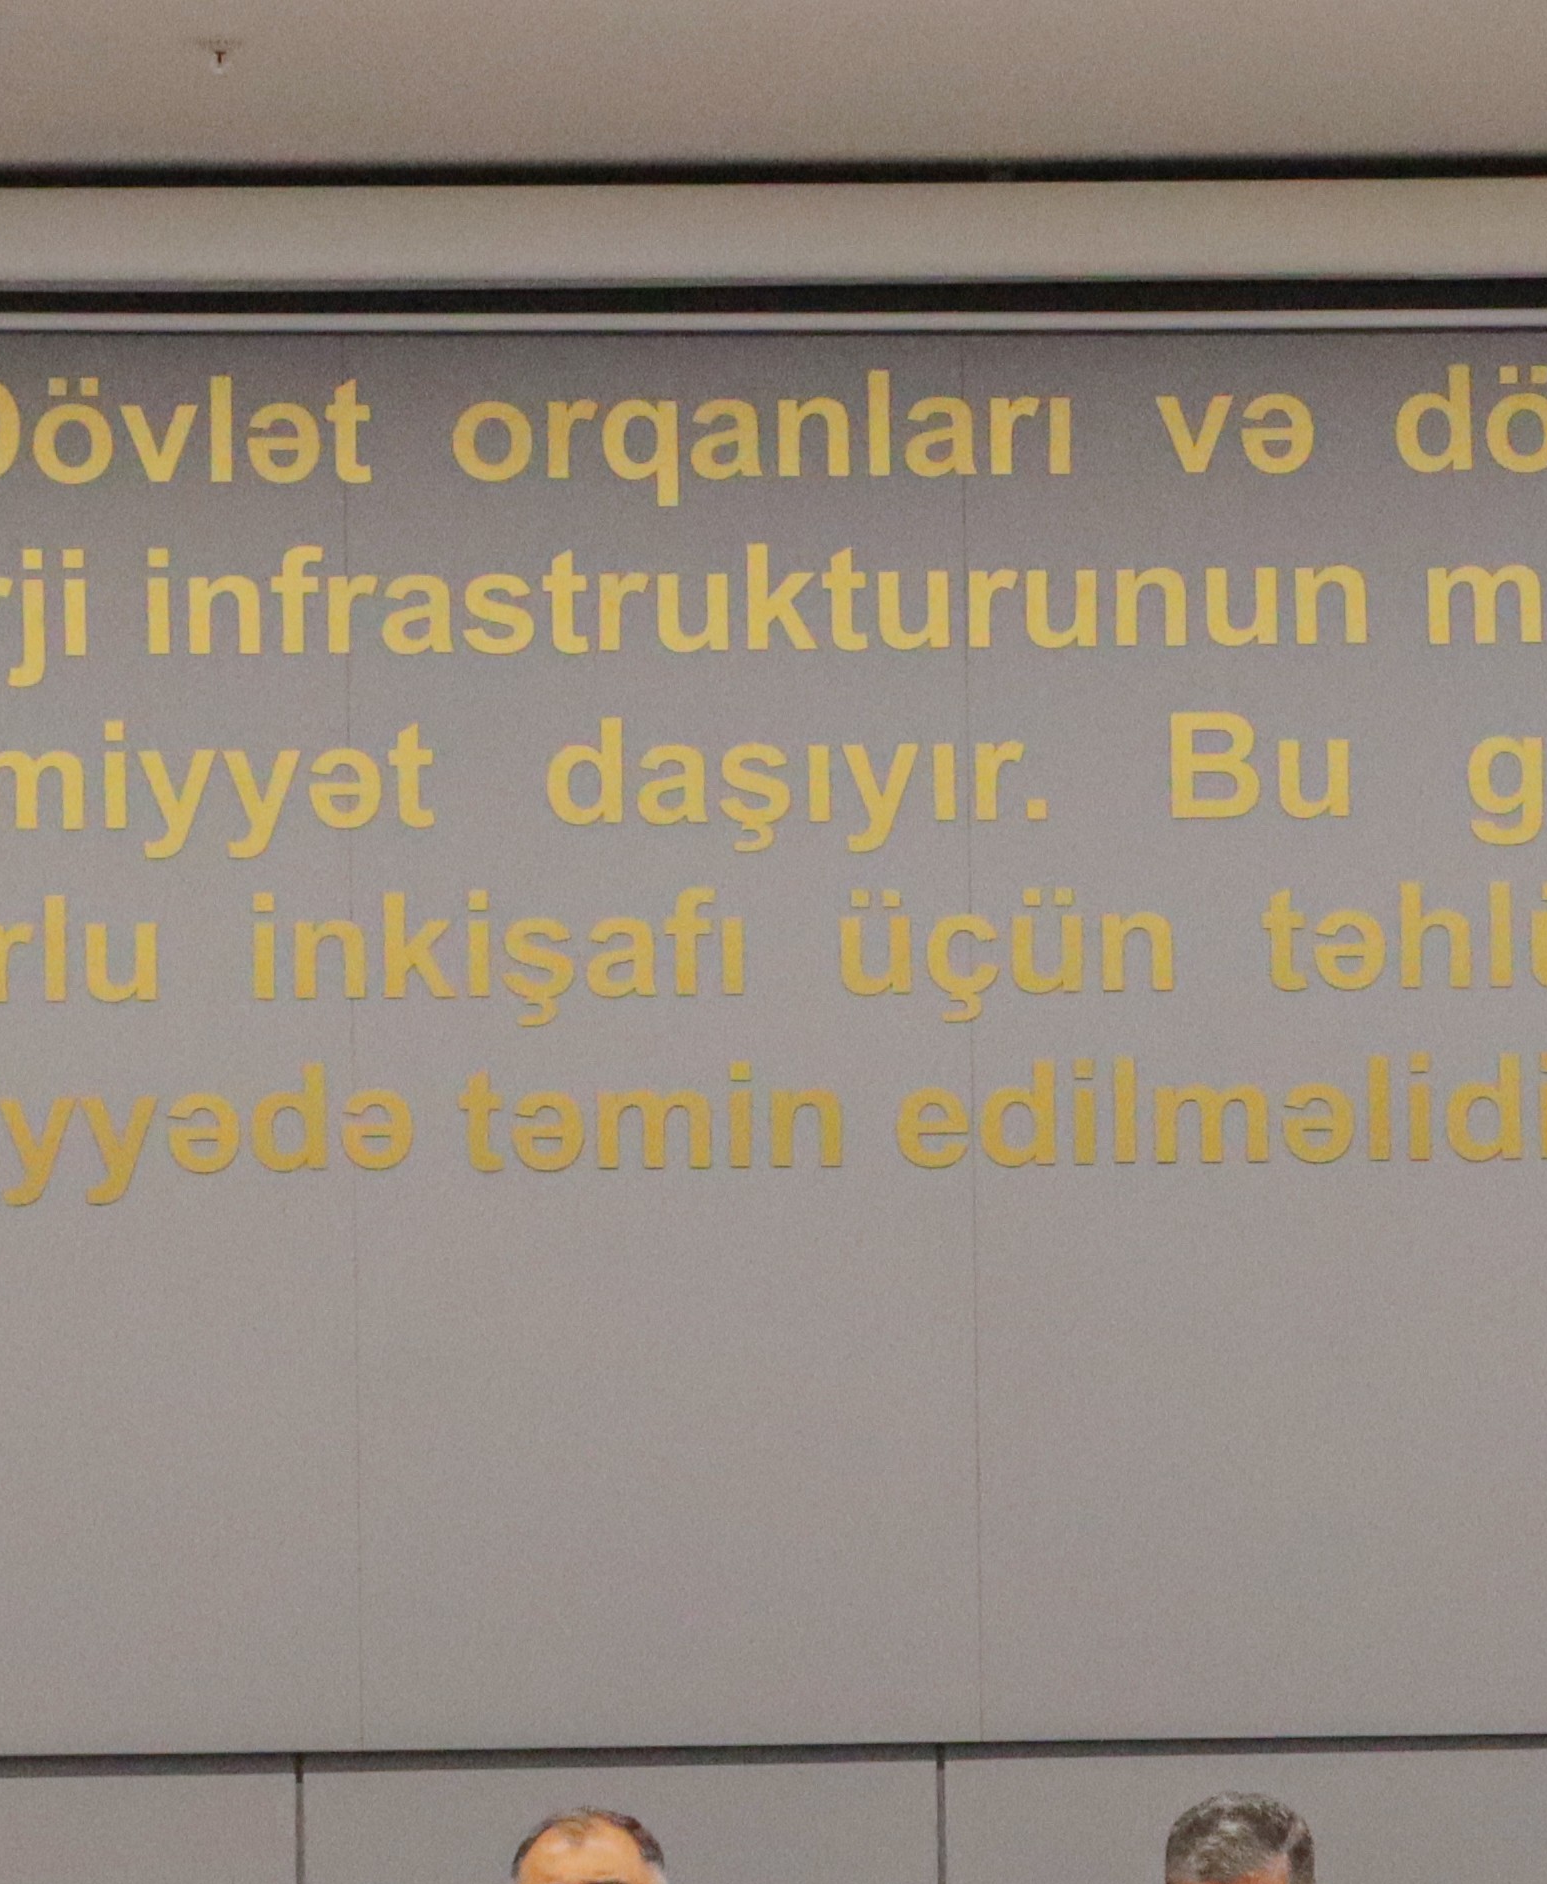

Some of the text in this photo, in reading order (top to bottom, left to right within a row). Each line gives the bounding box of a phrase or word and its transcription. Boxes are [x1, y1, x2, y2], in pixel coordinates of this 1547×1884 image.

[451, 369, 1073, 508] orqanları
[1157, 392, 1315, 475] və
[146, 541, 1369, 656] infrastrukturunun
[545, 716, 1049, 854] daşıyır.
[1169, 711, 1351, 820] Bu
[252, 886, 745, 1028] inkişafı
[838, 887, 1175, 1023] üçün
[457, 1060, 844, 1173] təmin
